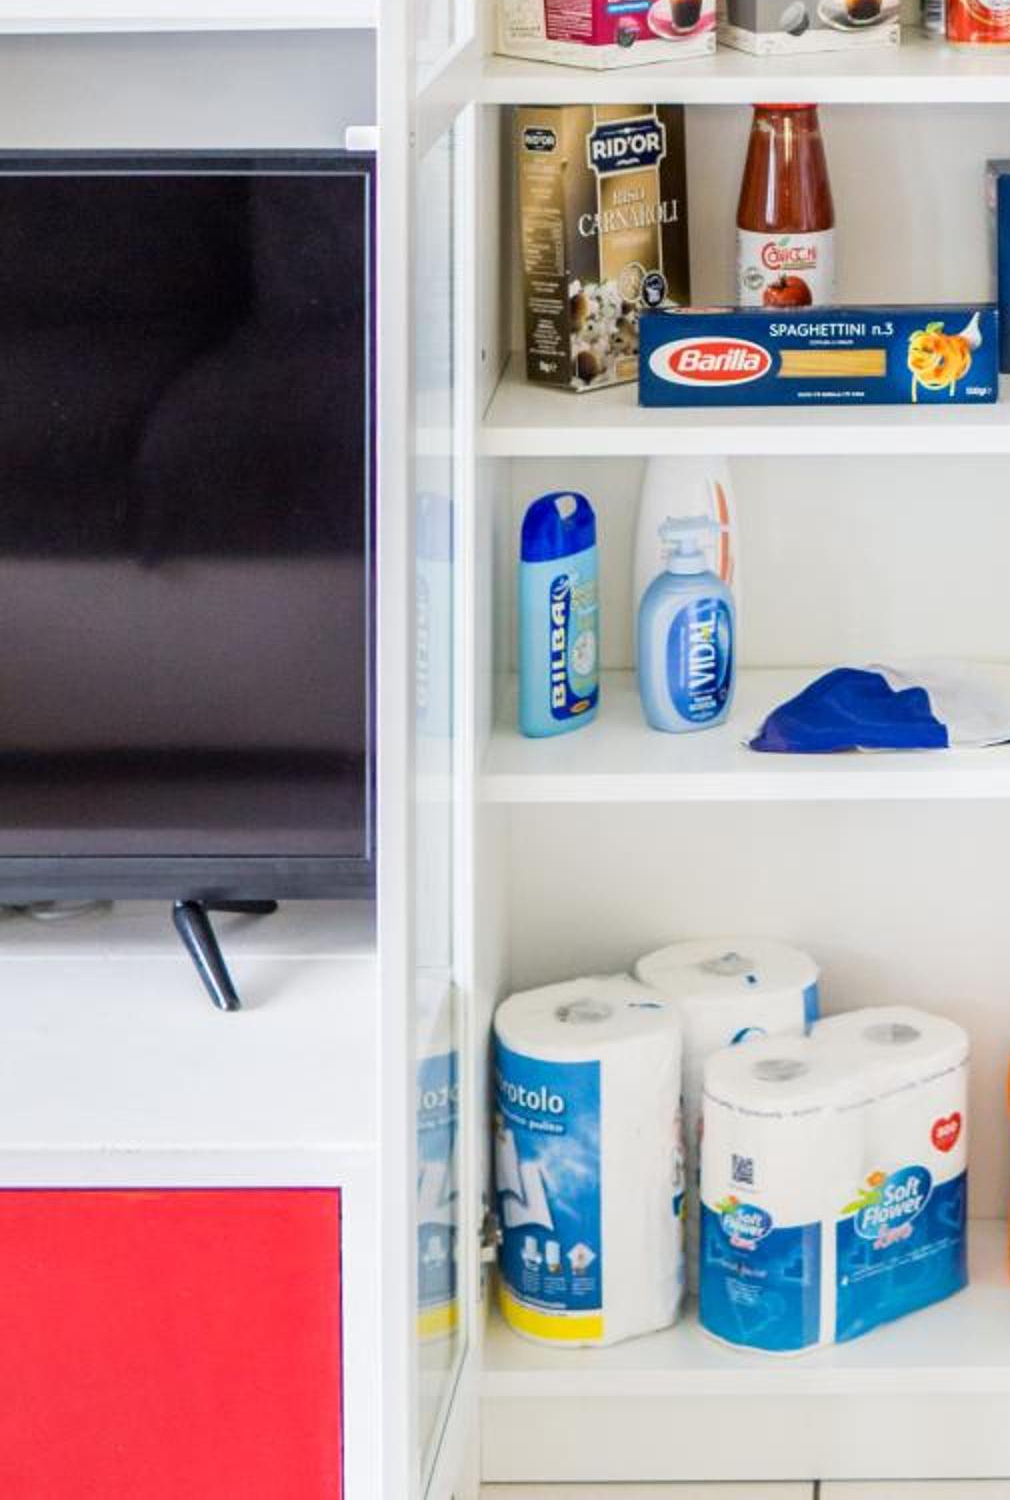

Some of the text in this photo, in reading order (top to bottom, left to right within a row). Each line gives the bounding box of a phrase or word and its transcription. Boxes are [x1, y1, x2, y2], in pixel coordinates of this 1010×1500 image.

[591, 131, 660, 161] RID'OR
[577, 199, 679, 237] CARNAROLI
[769, 322, 894, 338] SPAGHETTINI n.3
[676, 348, 761, 373] Barilla
[689, 611, 716, 692] VIDAL
[884, 1175, 921, 1206] Soft
[861, 1192, 923, 1231] Flower
